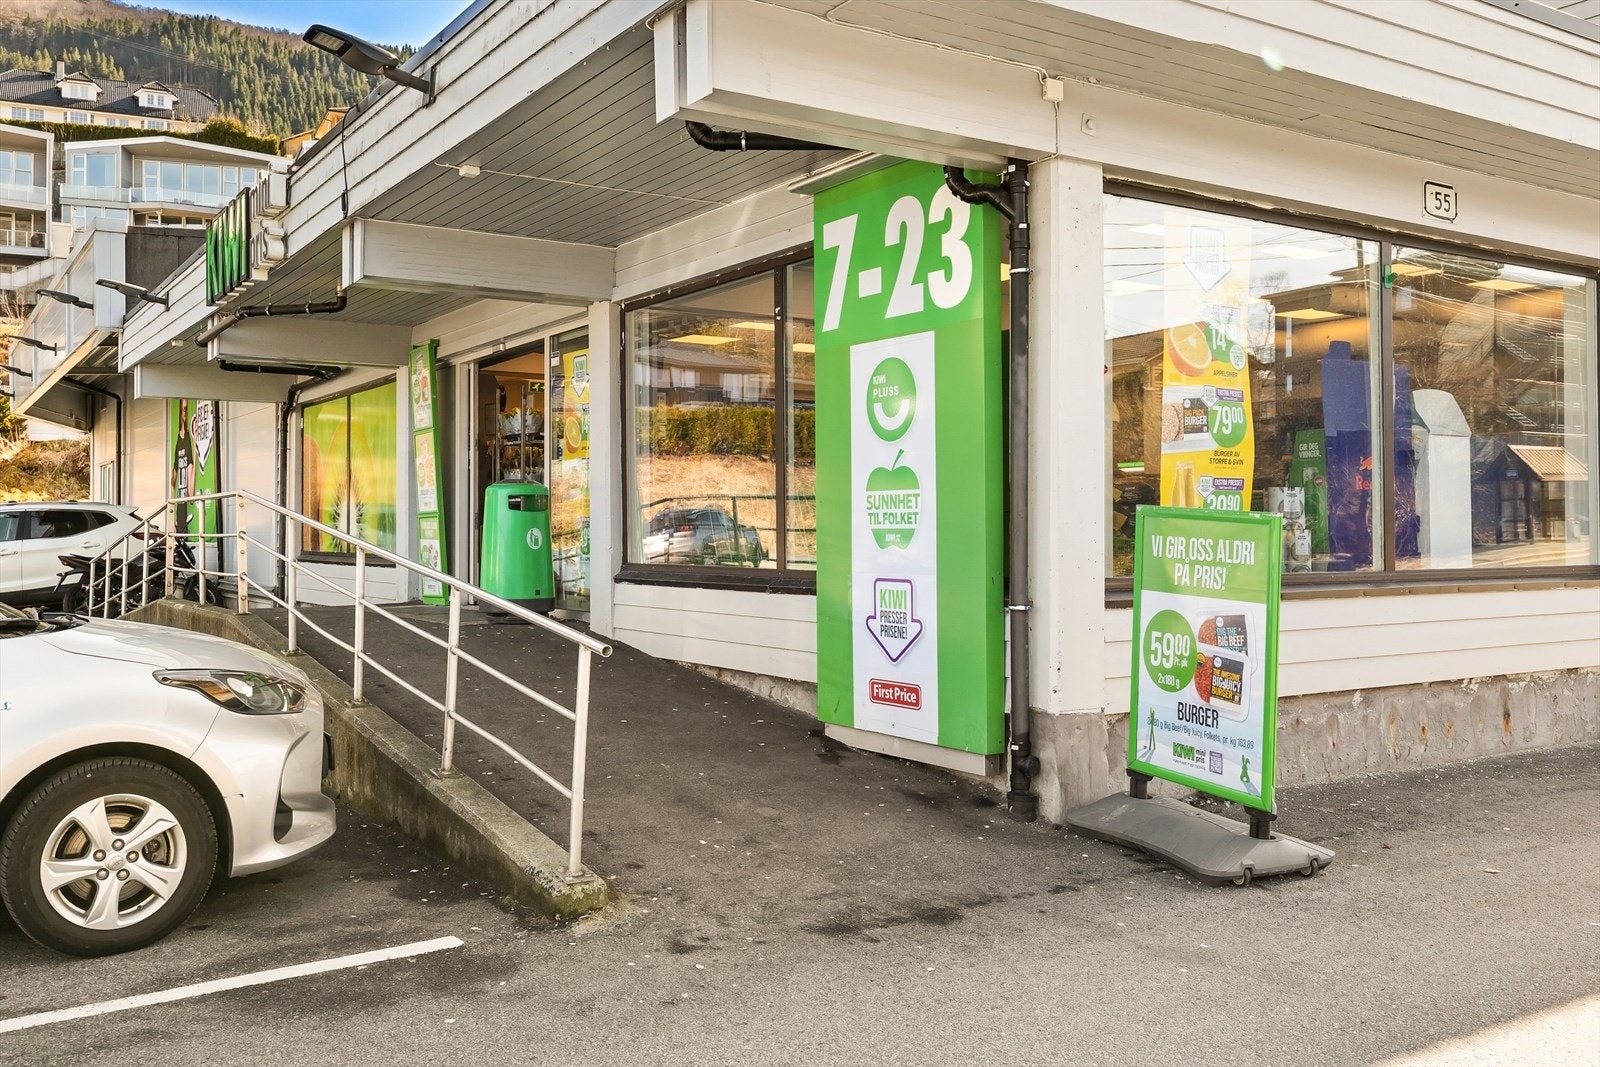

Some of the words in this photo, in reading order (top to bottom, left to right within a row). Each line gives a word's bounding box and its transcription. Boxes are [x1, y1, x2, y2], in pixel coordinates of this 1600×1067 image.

[822, 183, 973, 332] 7-23
[873, 374, 886, 385] KIWI
[873, 385, 899, 398] PLUSS
[1184, 416, 1207, 426] BURGER
[1309, 442, 1318, 450] DEG
[1355, 475, 1372, 490] Re
[866, 493, 920, 510] SUNNHET
[868, 512, 881, 525] TIL
[883, 511, 919, 525] FOLKET
[1152, 535, 1163, 557] VI
[1165, 536, 1186, 559] GIR
[1189, 537, 1213, 562] OSS
[1216, 539, 1255, 565] ALDRI
[1174, 557, 1190, 587] PÅ
[1193, 564, 1226, 590] PRIS!
[880, 589, 907, 610] KIWI
[880, 610, 907, 625] PRESSER
[880, 624, 907, 639] PRISENE!
[1217, 636, 1229, 647] BIG
[1229, 635, 1244, 647] BEEF
[1175, 679, 1180, 689] g
[873, 684, 894, 700] First
[895, 687, 917, 703] Price
[1177, 702, 1219, 729] BURGER
[1230, 738, 1237, 747] kg
[1173, 742, 1194, 761] KIWI
